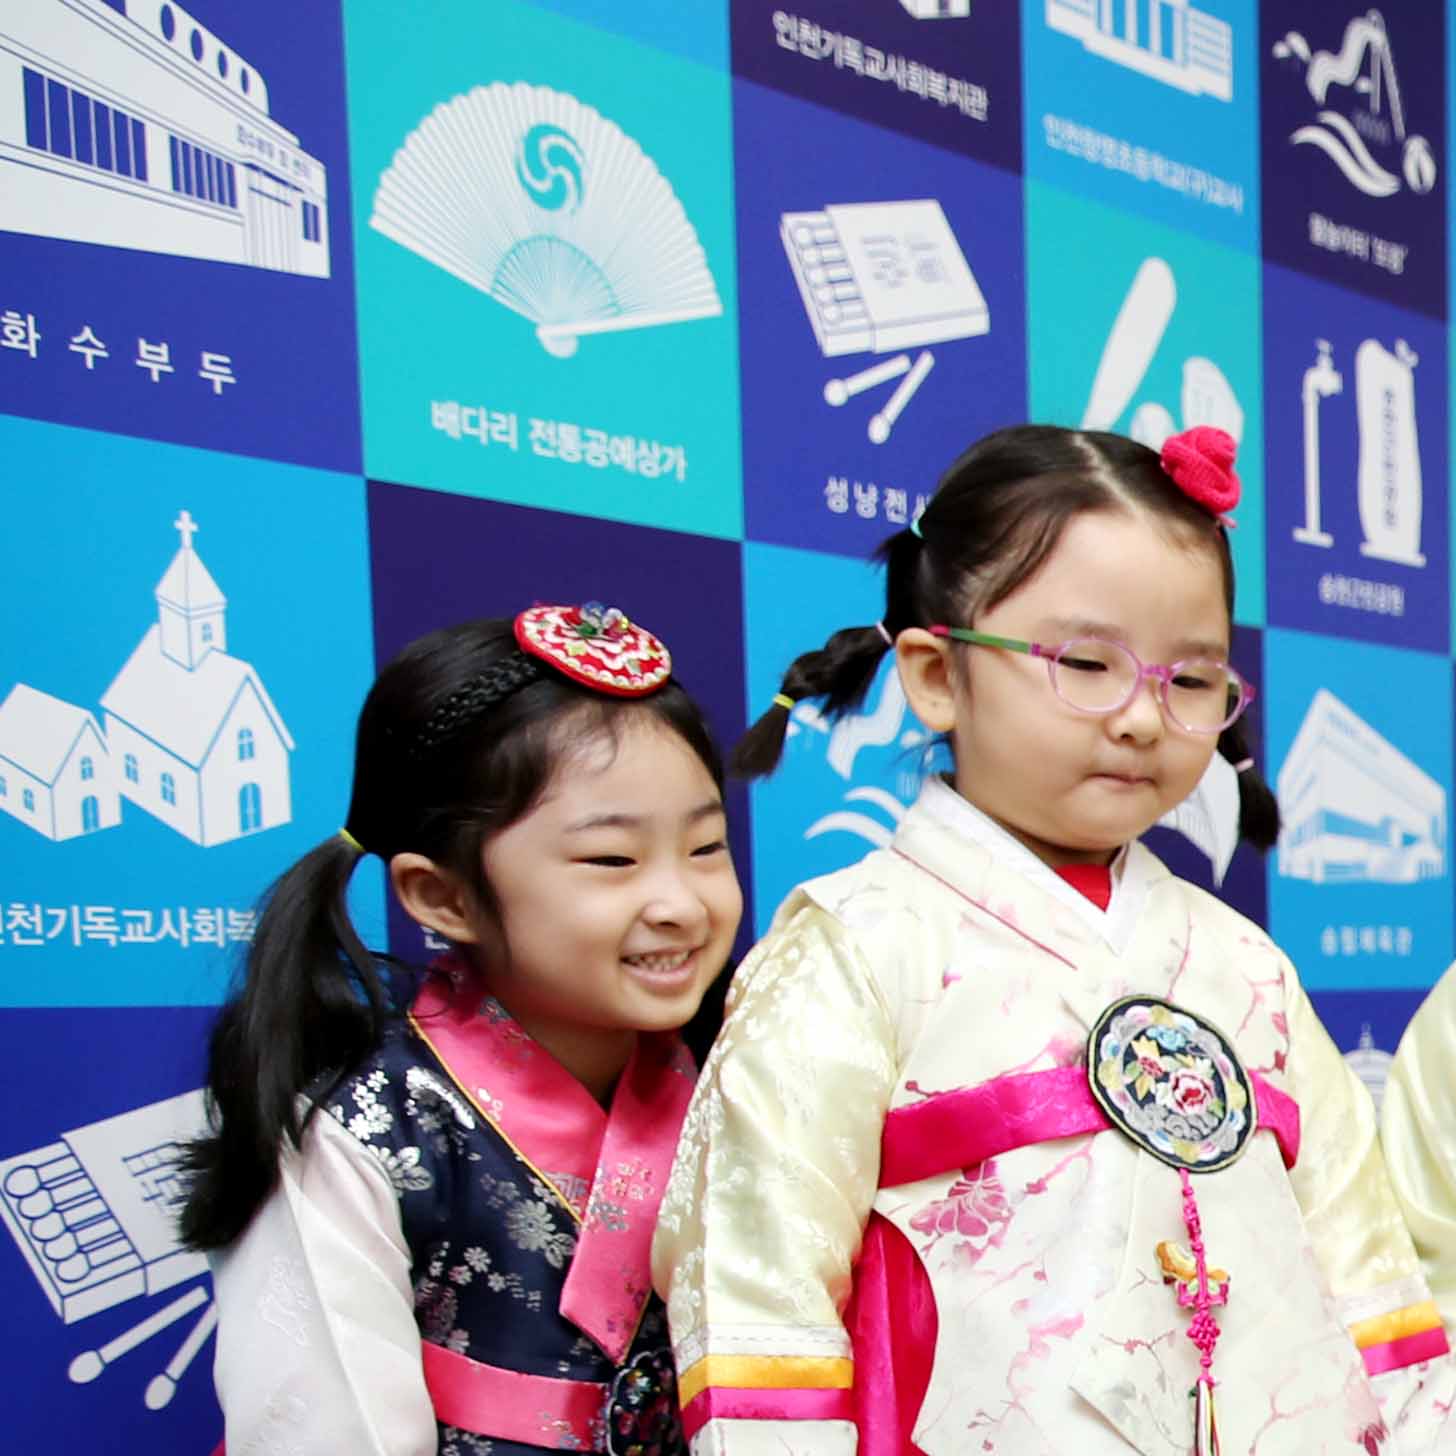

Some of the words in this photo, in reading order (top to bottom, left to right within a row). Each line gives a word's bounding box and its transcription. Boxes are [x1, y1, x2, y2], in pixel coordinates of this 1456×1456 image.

[431, 399, 518, 451] 배다리
[528, 417, 688, 482] 전통공예상가
[0, 903, 258, 949] 천기독교사회복
